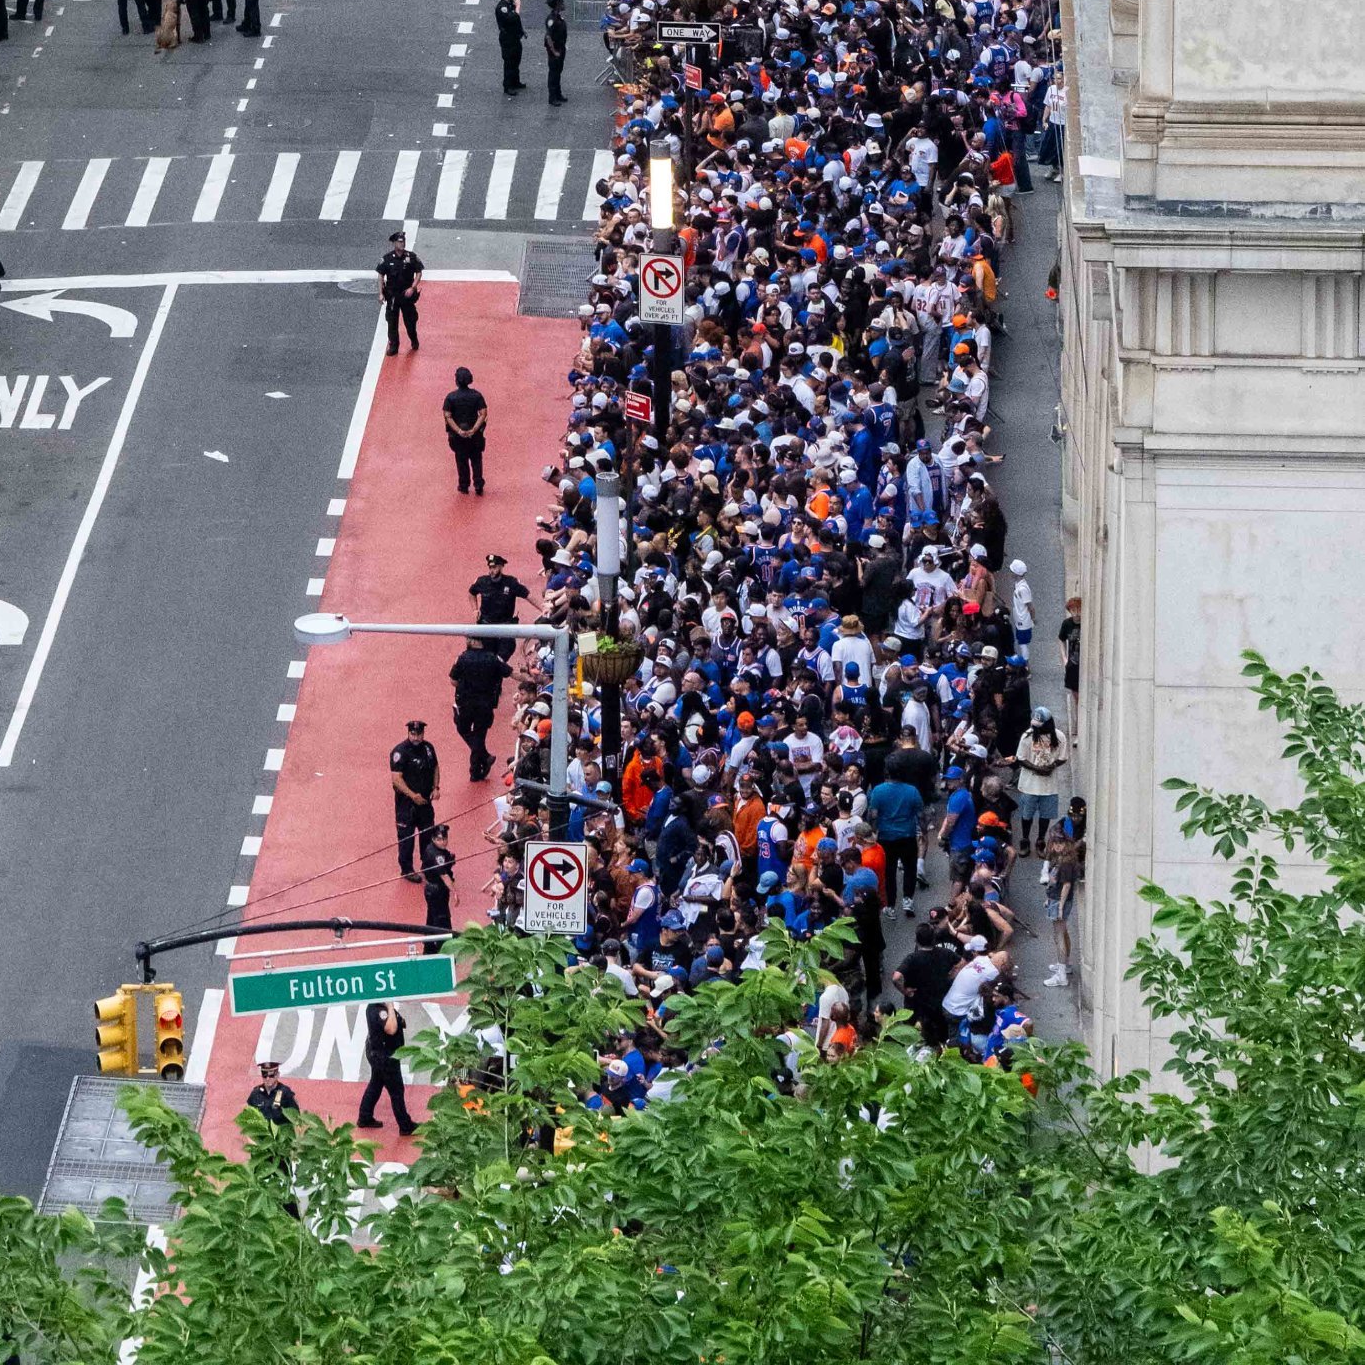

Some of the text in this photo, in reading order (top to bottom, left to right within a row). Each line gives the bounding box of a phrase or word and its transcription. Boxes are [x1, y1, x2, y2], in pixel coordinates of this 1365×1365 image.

[916, 298, 927, 312] 32
[648, 306, 675, 314] VEHICLES
[535, 911, 577, 920] VEHICLES
[530, 920, 554, 928] OVER
[570, 921, 580, 929] FT
[289, 969, 397, 1001] Fulton St
